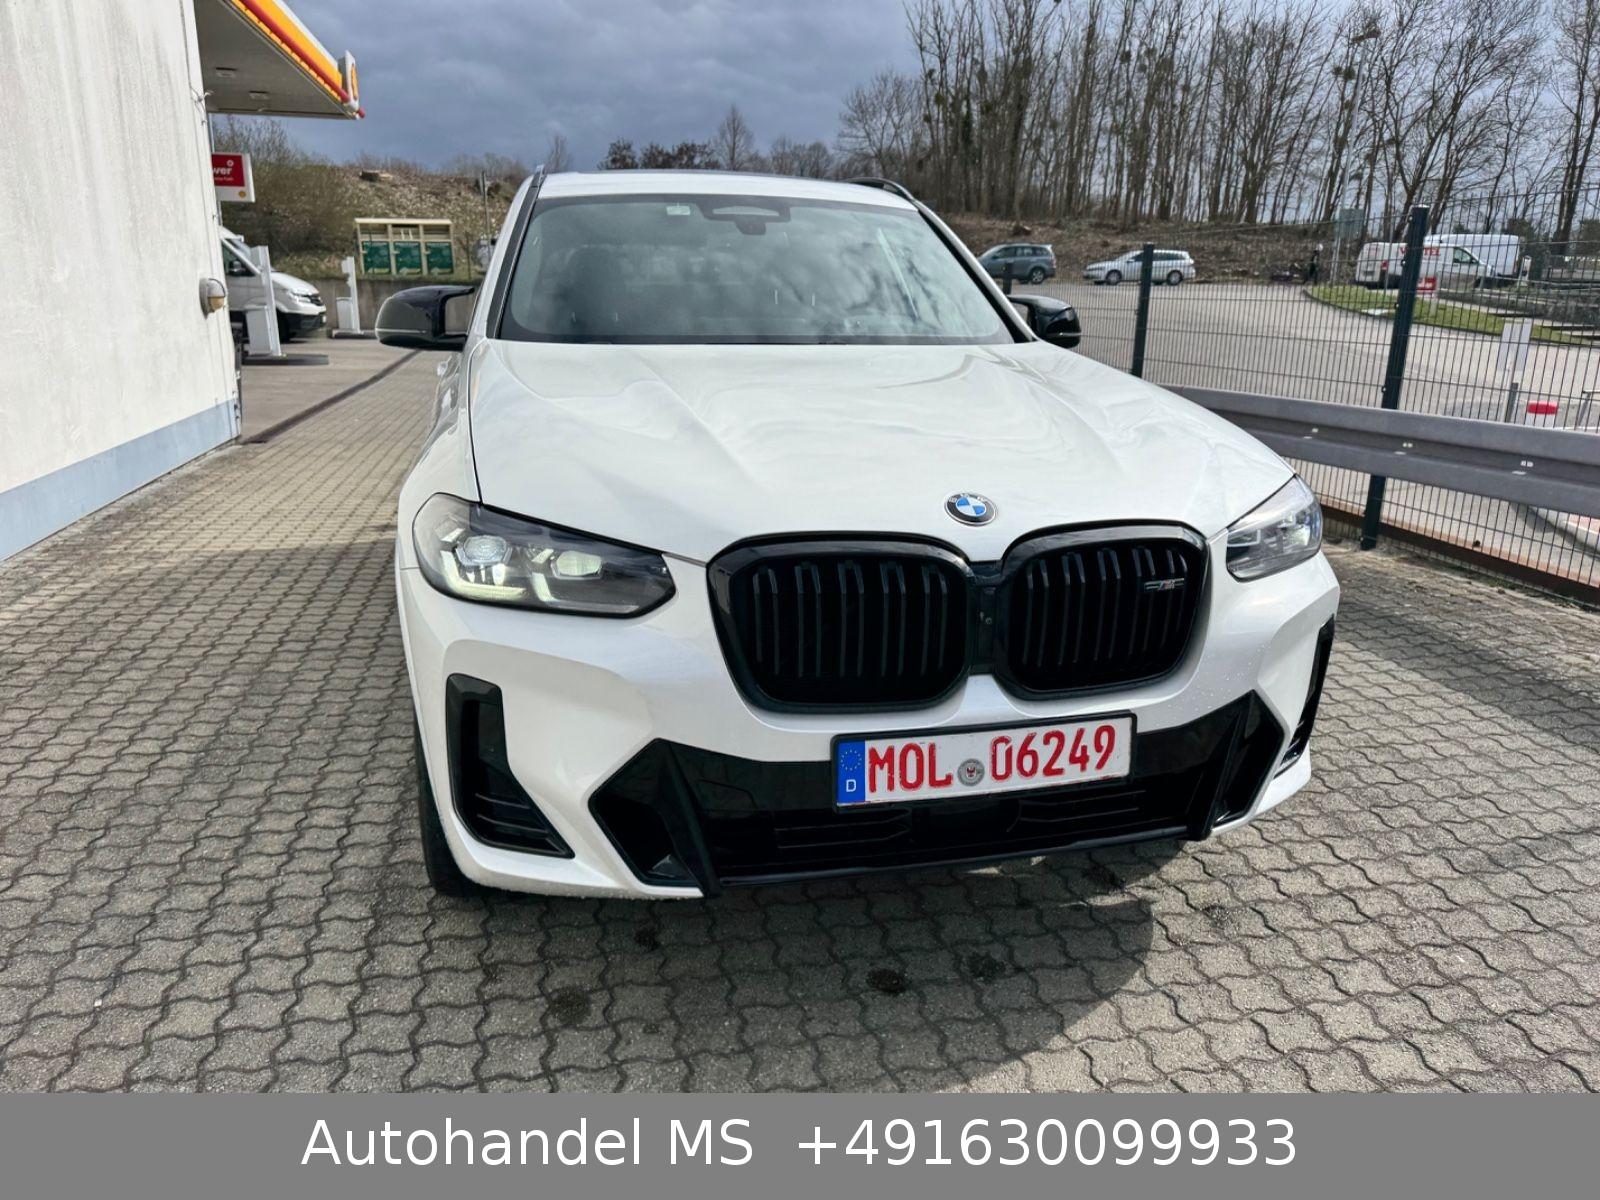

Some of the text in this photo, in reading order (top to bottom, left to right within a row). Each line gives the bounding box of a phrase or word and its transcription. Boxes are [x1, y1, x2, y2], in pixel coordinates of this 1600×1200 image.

[868, 743, 953, 793] MOL
[991, 725, 1116, 781] 06249
[845, 779, 857, 792] D
